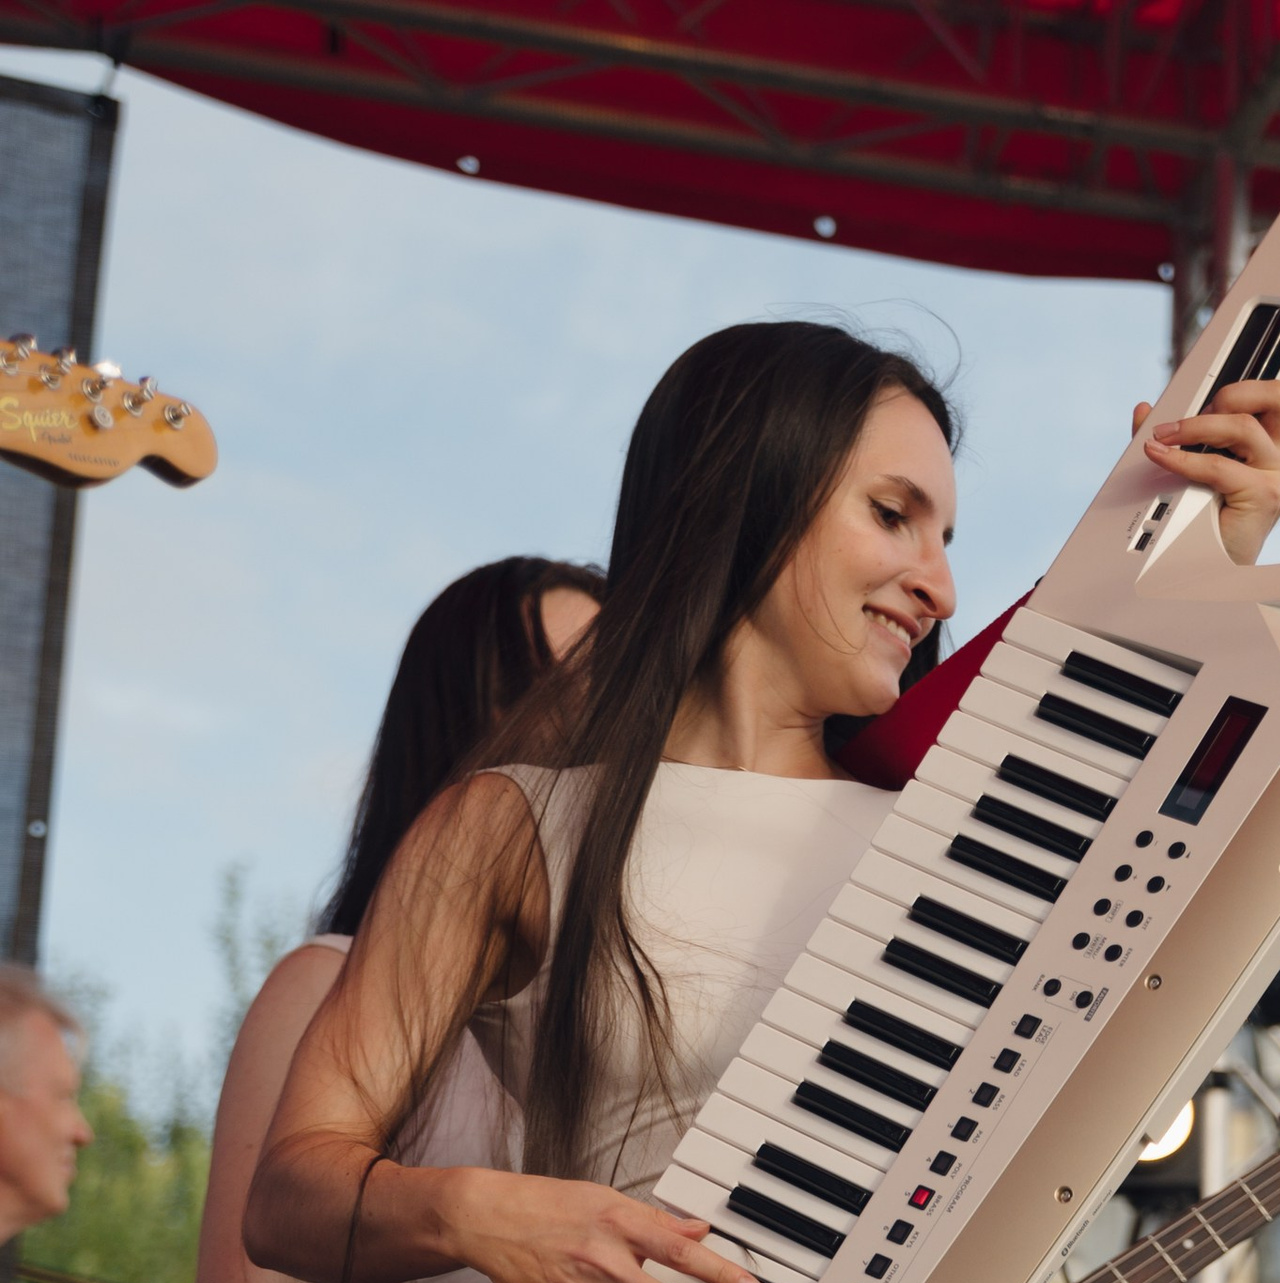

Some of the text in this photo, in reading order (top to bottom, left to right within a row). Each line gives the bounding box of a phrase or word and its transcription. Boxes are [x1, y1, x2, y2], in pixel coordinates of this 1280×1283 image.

[0, 396, 79, 442] Squier
[1108, 902, 1121, 920] SHIFT
[1141, 916, 1152, 930] EXIT
[1118, 947, 1132, 967] ENTER
[1085, 988, 1108, 1021] FAVORITE
[1034, 1024, 1047, 1042] LEAD
[1039, 1026, 1053, 1044] EDGE
[1013, 1059, 1026, 1077] LEAD
[992, 1093, 1005, 1110] BASS
[971, 1129, 982, 1143] PAD
[950, 1162, 962, 1179] POLY
[946, 1175, 972, 1213] PROGRAM
[926, 1194, 942, 1215] BRASS
[906, 1230, 919, 1247] KEYS
[1067, 1220, 1090, 1249] Bluetooth
